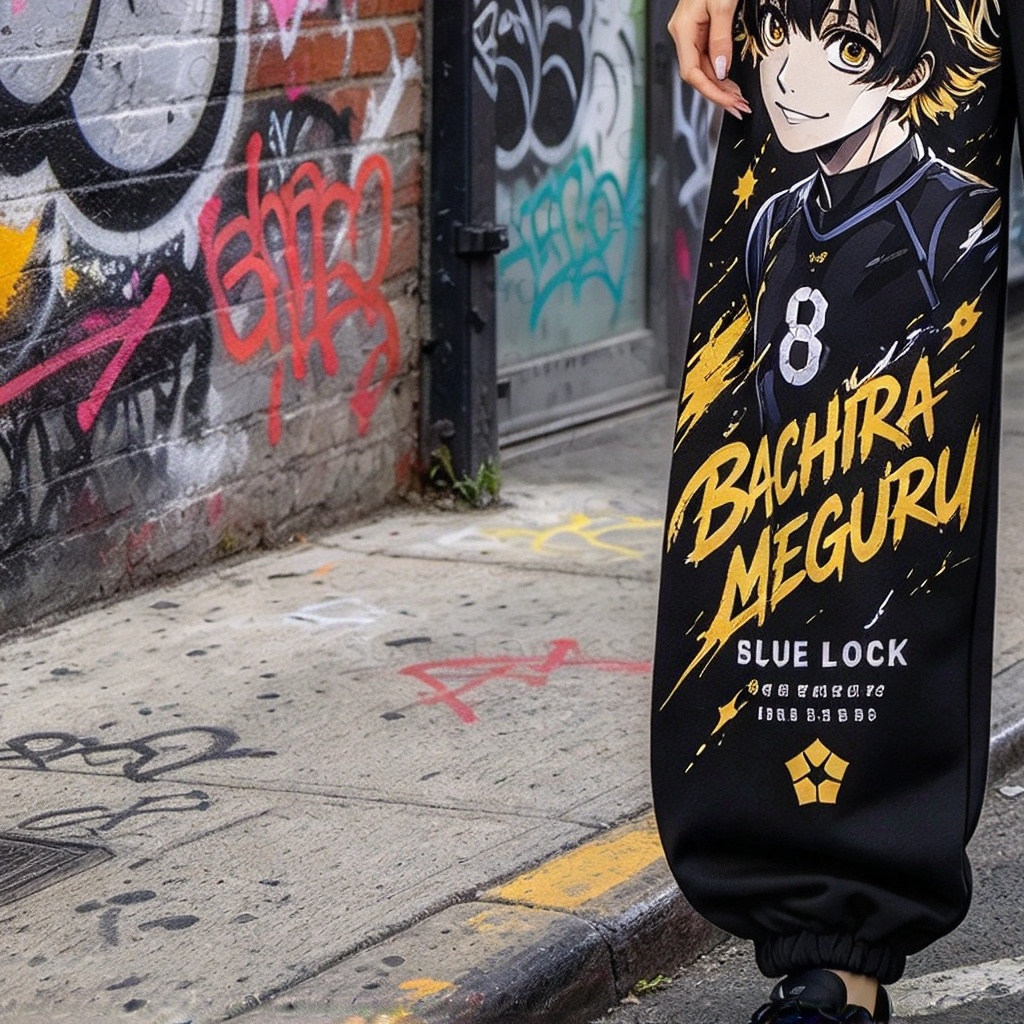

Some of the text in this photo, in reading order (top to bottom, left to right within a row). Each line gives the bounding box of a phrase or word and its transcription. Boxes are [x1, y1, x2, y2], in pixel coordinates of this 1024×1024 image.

[779, 287, 829, 386] 8
[667, 351, 948, 568] BACHIRA
[688, 414, 981, 661] MEGURU
[822, 639, 908, 667] LOCK
